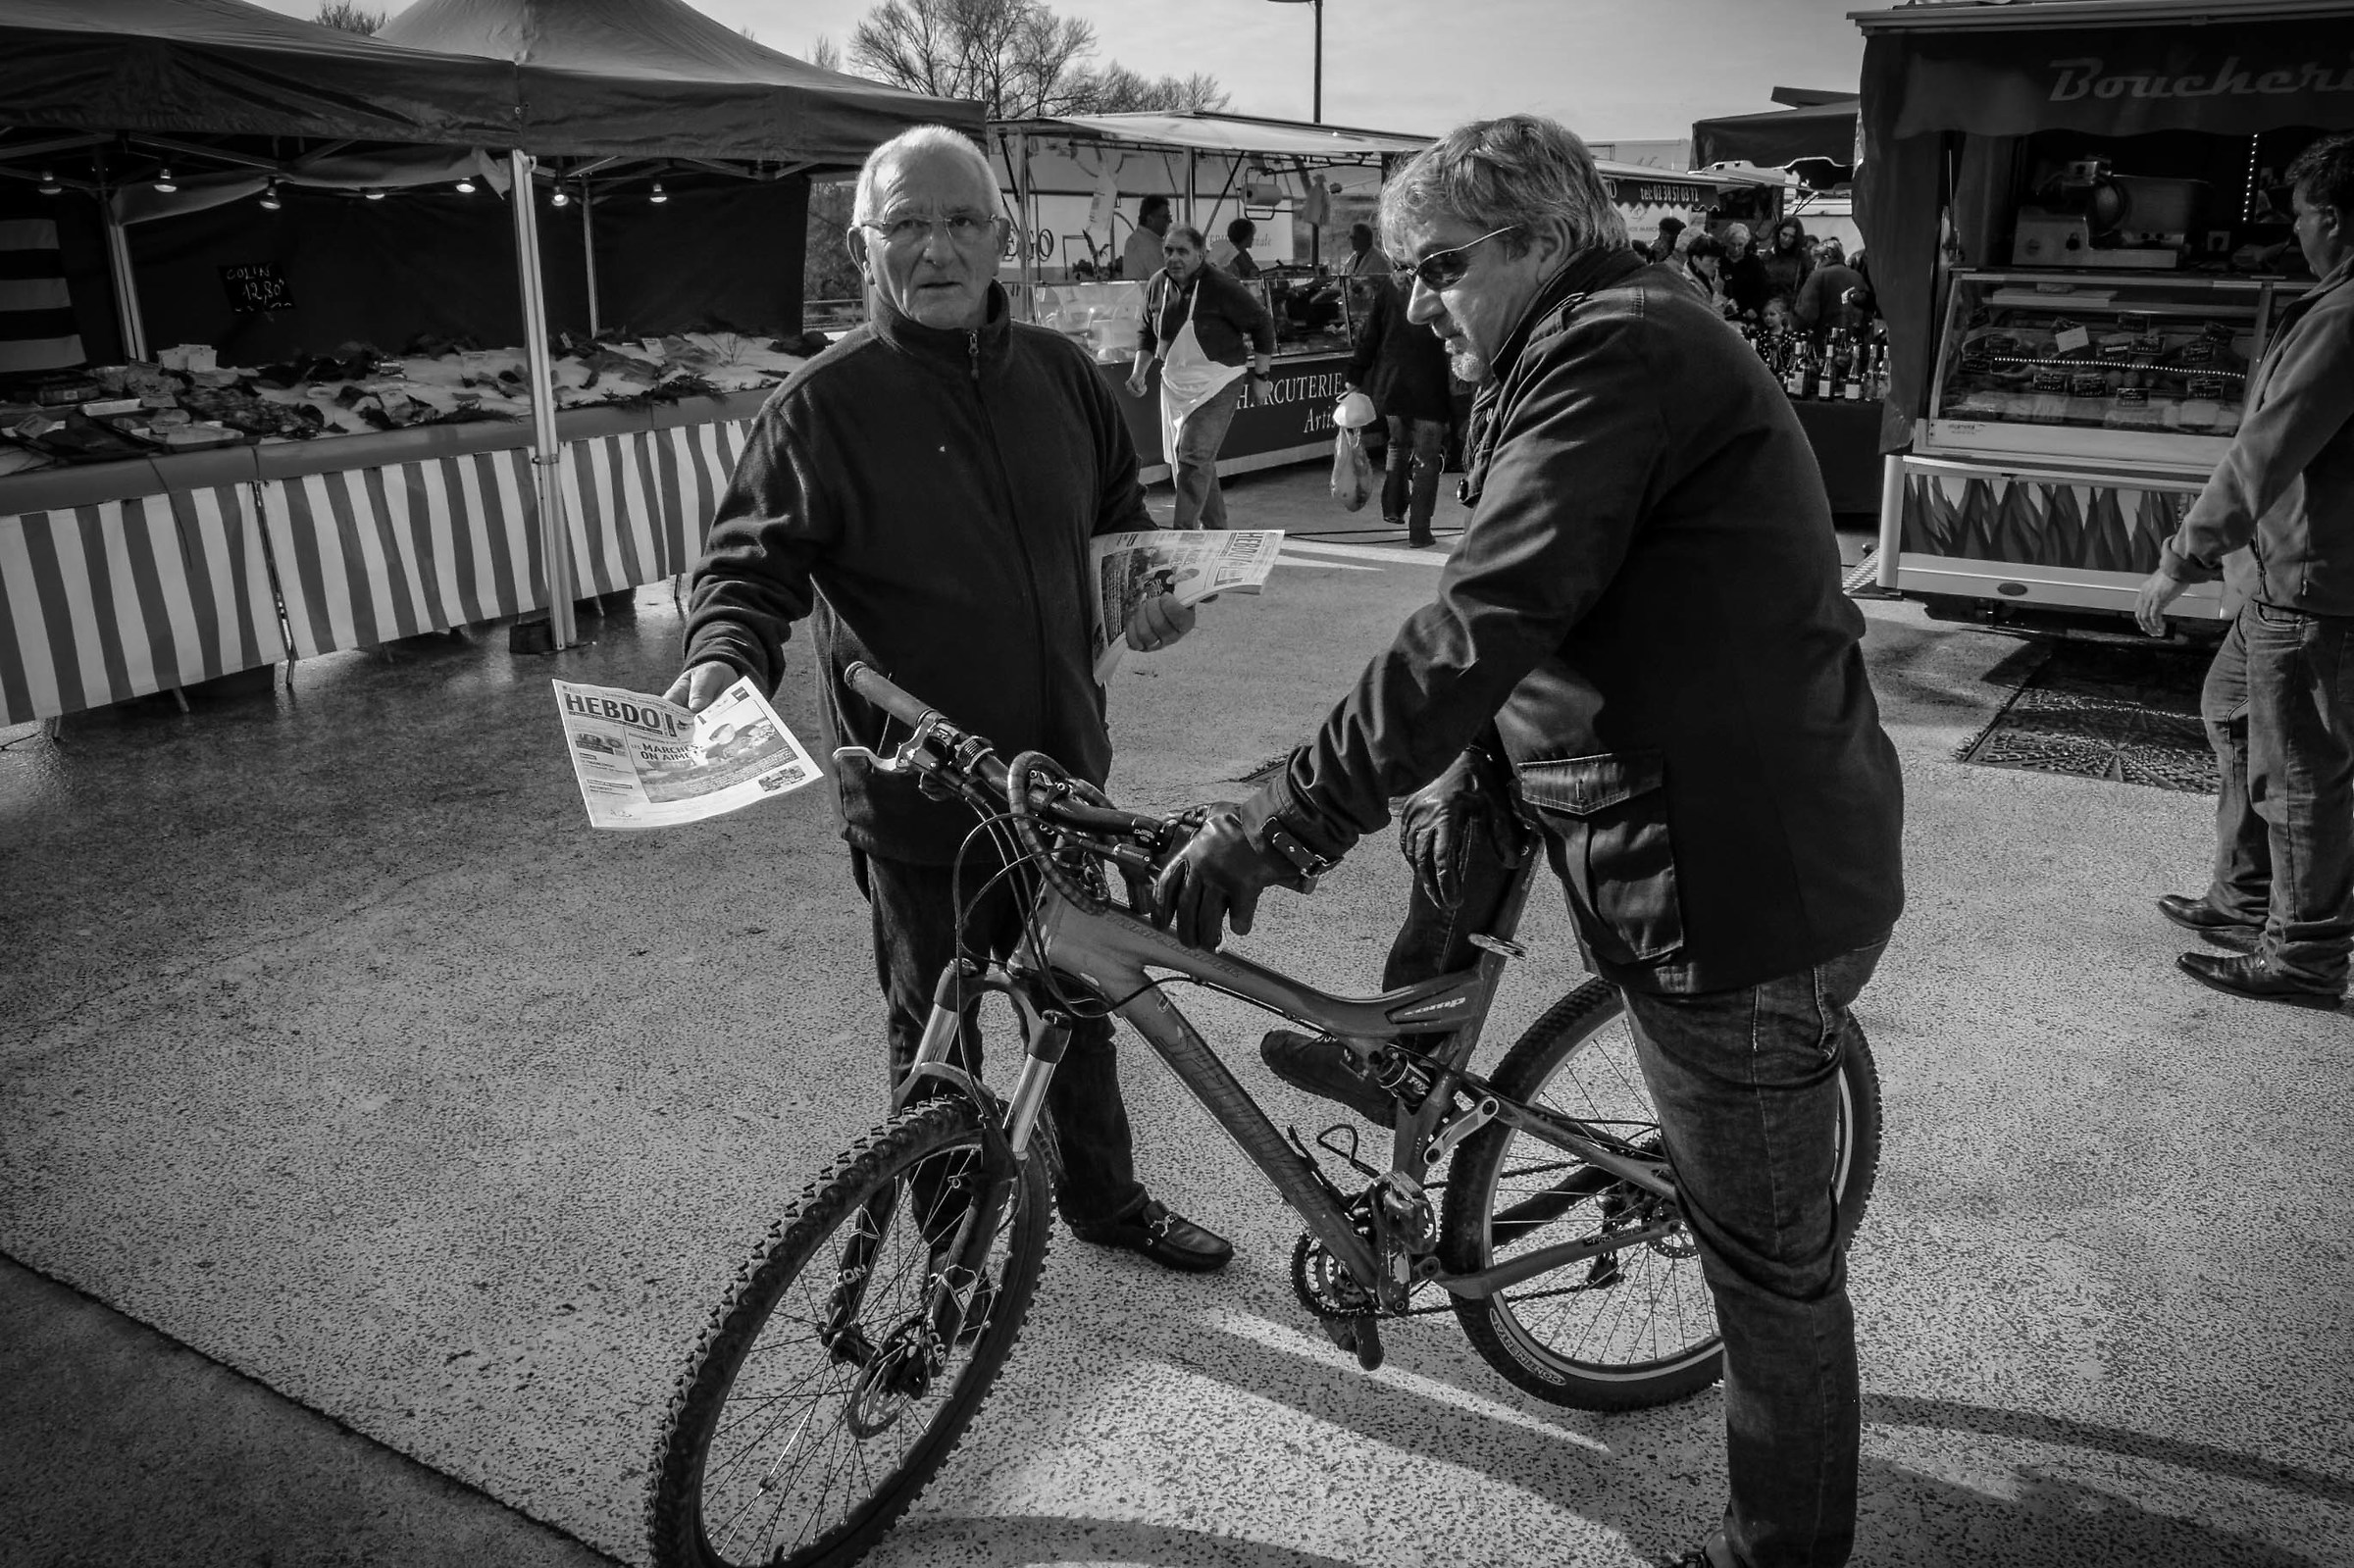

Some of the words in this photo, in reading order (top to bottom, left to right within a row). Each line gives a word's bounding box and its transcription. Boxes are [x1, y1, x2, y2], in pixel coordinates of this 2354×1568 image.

[1236, 373, 1342, 410] HRCUTERIE
[564, 692, 661, 729] HEBDO
[640, 750, 659, 761] ON
